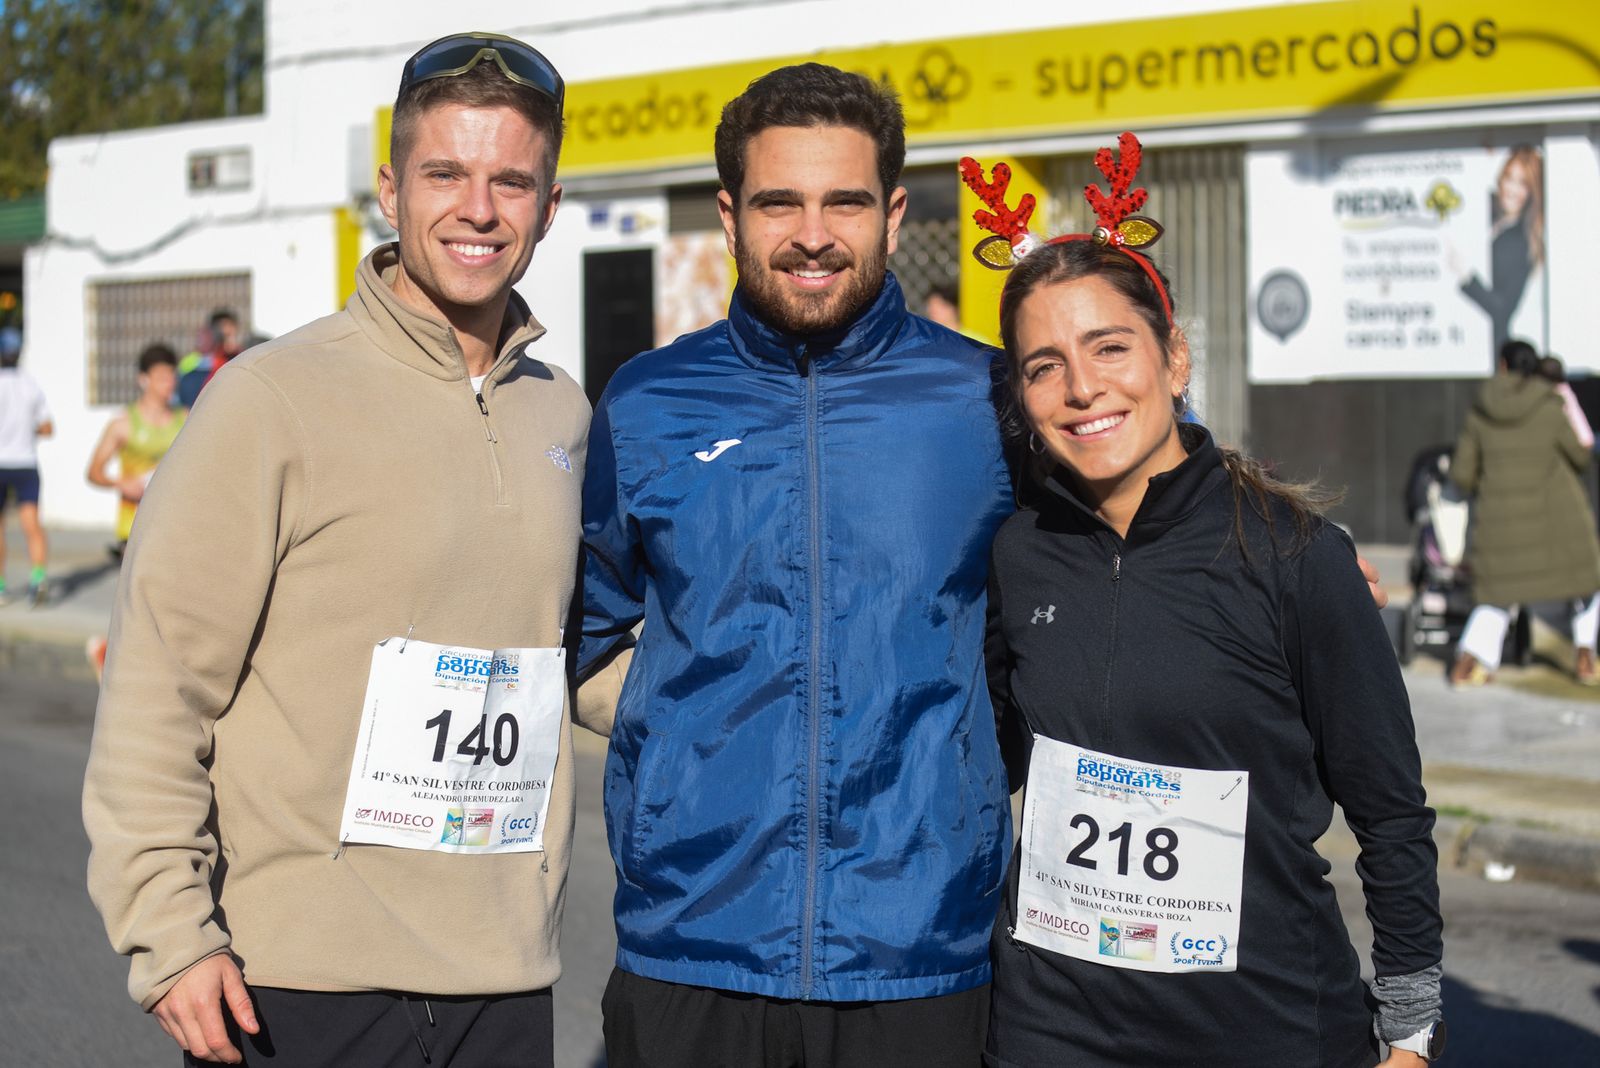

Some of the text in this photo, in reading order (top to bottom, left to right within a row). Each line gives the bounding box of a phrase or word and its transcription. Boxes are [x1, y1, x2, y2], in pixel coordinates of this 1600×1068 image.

[1035, 4, 1499, 112] supermercados
[434, 671, 487, 684] Diputación
[425, 709, 520, 766] 140
[1077, 758, 1163, 781] carreras
[1078, 752, 1112, 765] CIRCUITO
[1113, 760, 1162, 774] PROVINCIAL
[393, 774, 419, 786] SAN
[421, 777, 485, 791] SILVESTRE
[488, 779, 546, 791] CORDOBESA
[1076, 775, 1122, 792] Diputación
[1124, 786, 1136, 794] de
[1138, 789, 1180, 800] Córdoba
[1077, 764, 1181, 792] populares
[411, 791, 524, 804] ALEJANDRO BERMUDEZ LARA
[373, 809, 434, 828] IMDECO
[509, 817, 532, 830] GCC
[501, 836, 533, 845] SPORT EVENTS
[1065, 813, 1179, 882] 218
[1050, 876, 1072, 891] SAN
[1073, 882, 1144, 906] SILVESTRE
[1146, 896, 1233, 914] CORDOBESA
[1070, 896, 1192, 923] MIRIAM CAÑASVERAS BOZA
[1039, 911, 1090, 936] IMDECO
[1182, 938, 1216, 951] GCC
[1173, 957, 1223, 966] SPORT EVENTS
